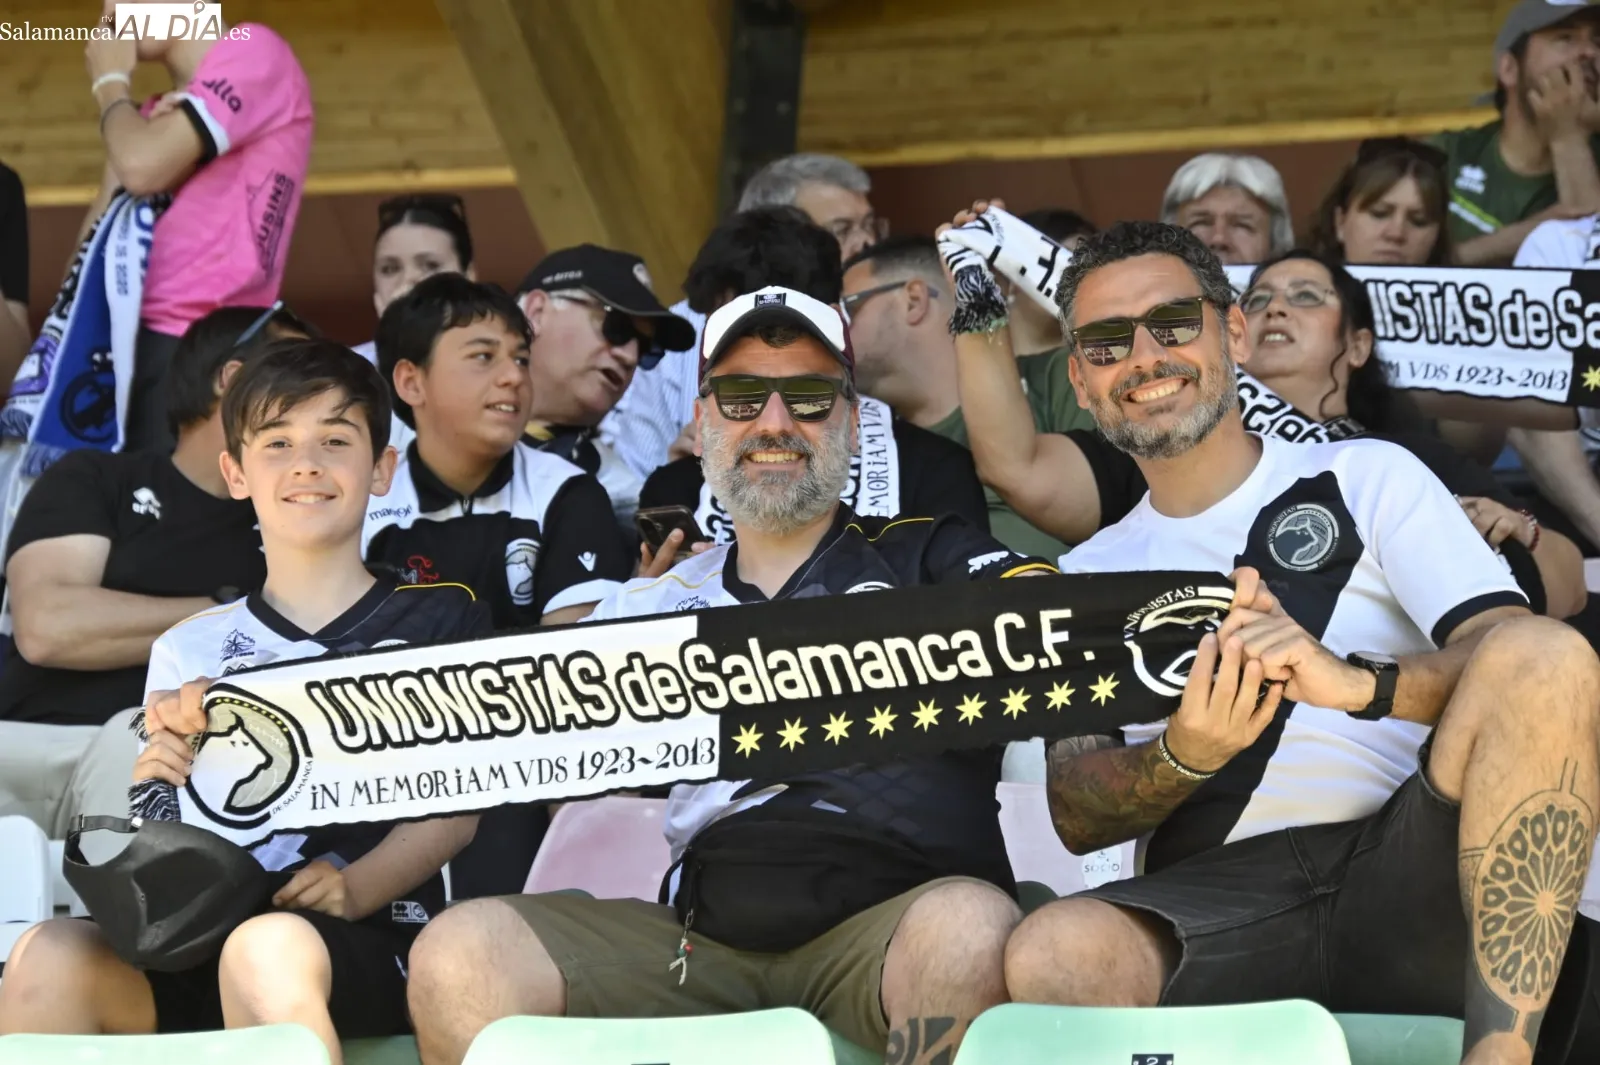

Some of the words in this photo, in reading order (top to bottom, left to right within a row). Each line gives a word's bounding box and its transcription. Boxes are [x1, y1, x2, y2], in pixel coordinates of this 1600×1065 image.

[1498, 289, 1553, 349] de
[1408, 360, 1450, 380] VDS
[305, 650, 621, 754] UNIONISTAS
[614, 651, 692, 723] de
[679, 628, 994, 715] Salamanca
[514, 756, 568, 787] VDS
